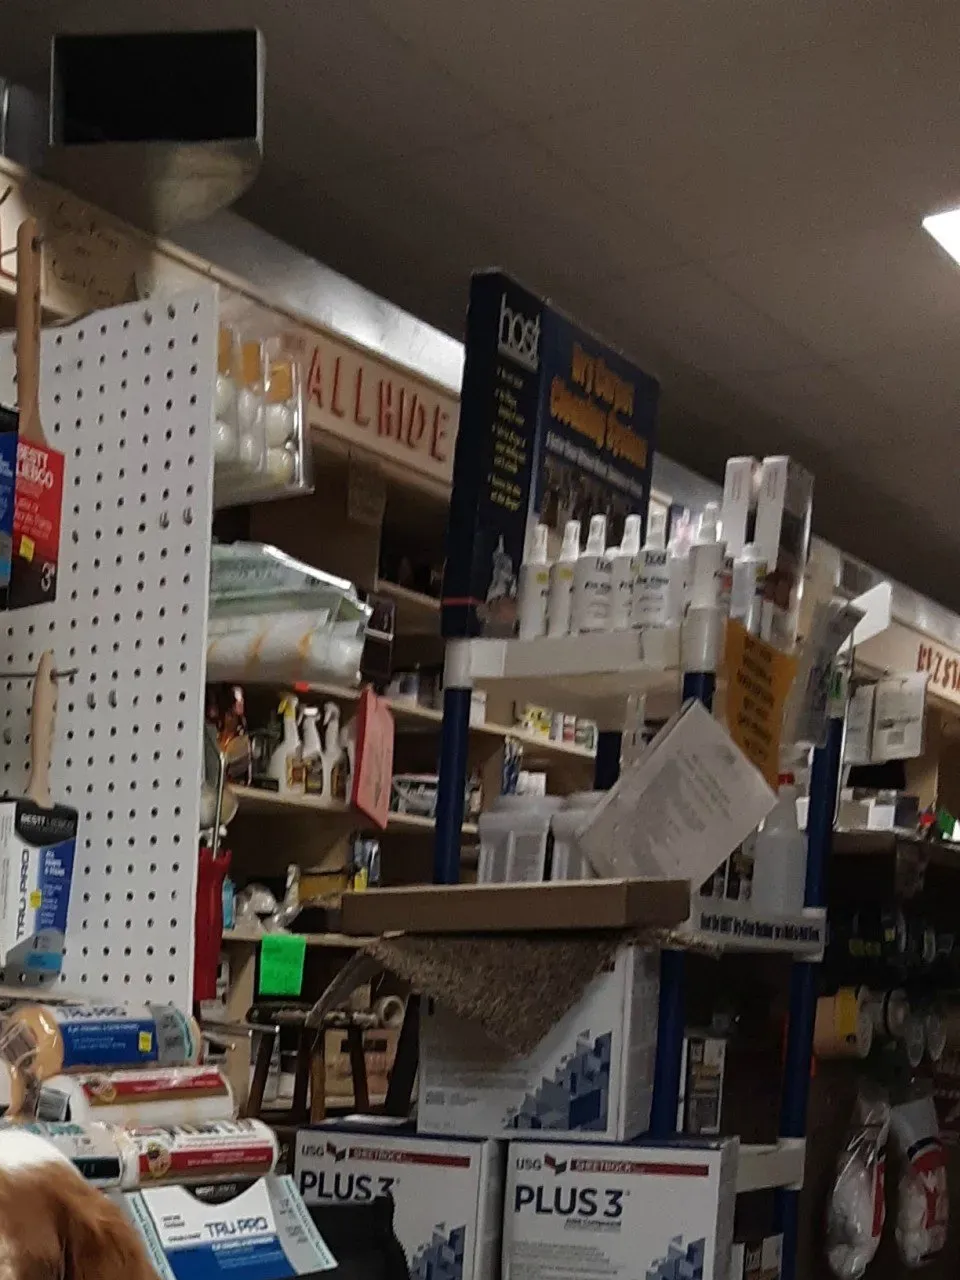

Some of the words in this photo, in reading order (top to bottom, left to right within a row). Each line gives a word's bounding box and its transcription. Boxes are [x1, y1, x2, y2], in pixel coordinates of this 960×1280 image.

[497, 292, 540, 368] host
[307, 344, 450, 463] ALLHIDE
[16, 848, 29, 940] TRU-PRO
[302, 1145, 325, 1158] USG
[515, 1156, 542, 1172] USG
[300, 1170, 372, 1201] PLUS
[375, 1175, 396, 1198] 3
[514, 1185, 598, 1217] PLUS
[603, 1188, 625, 1219] 3
